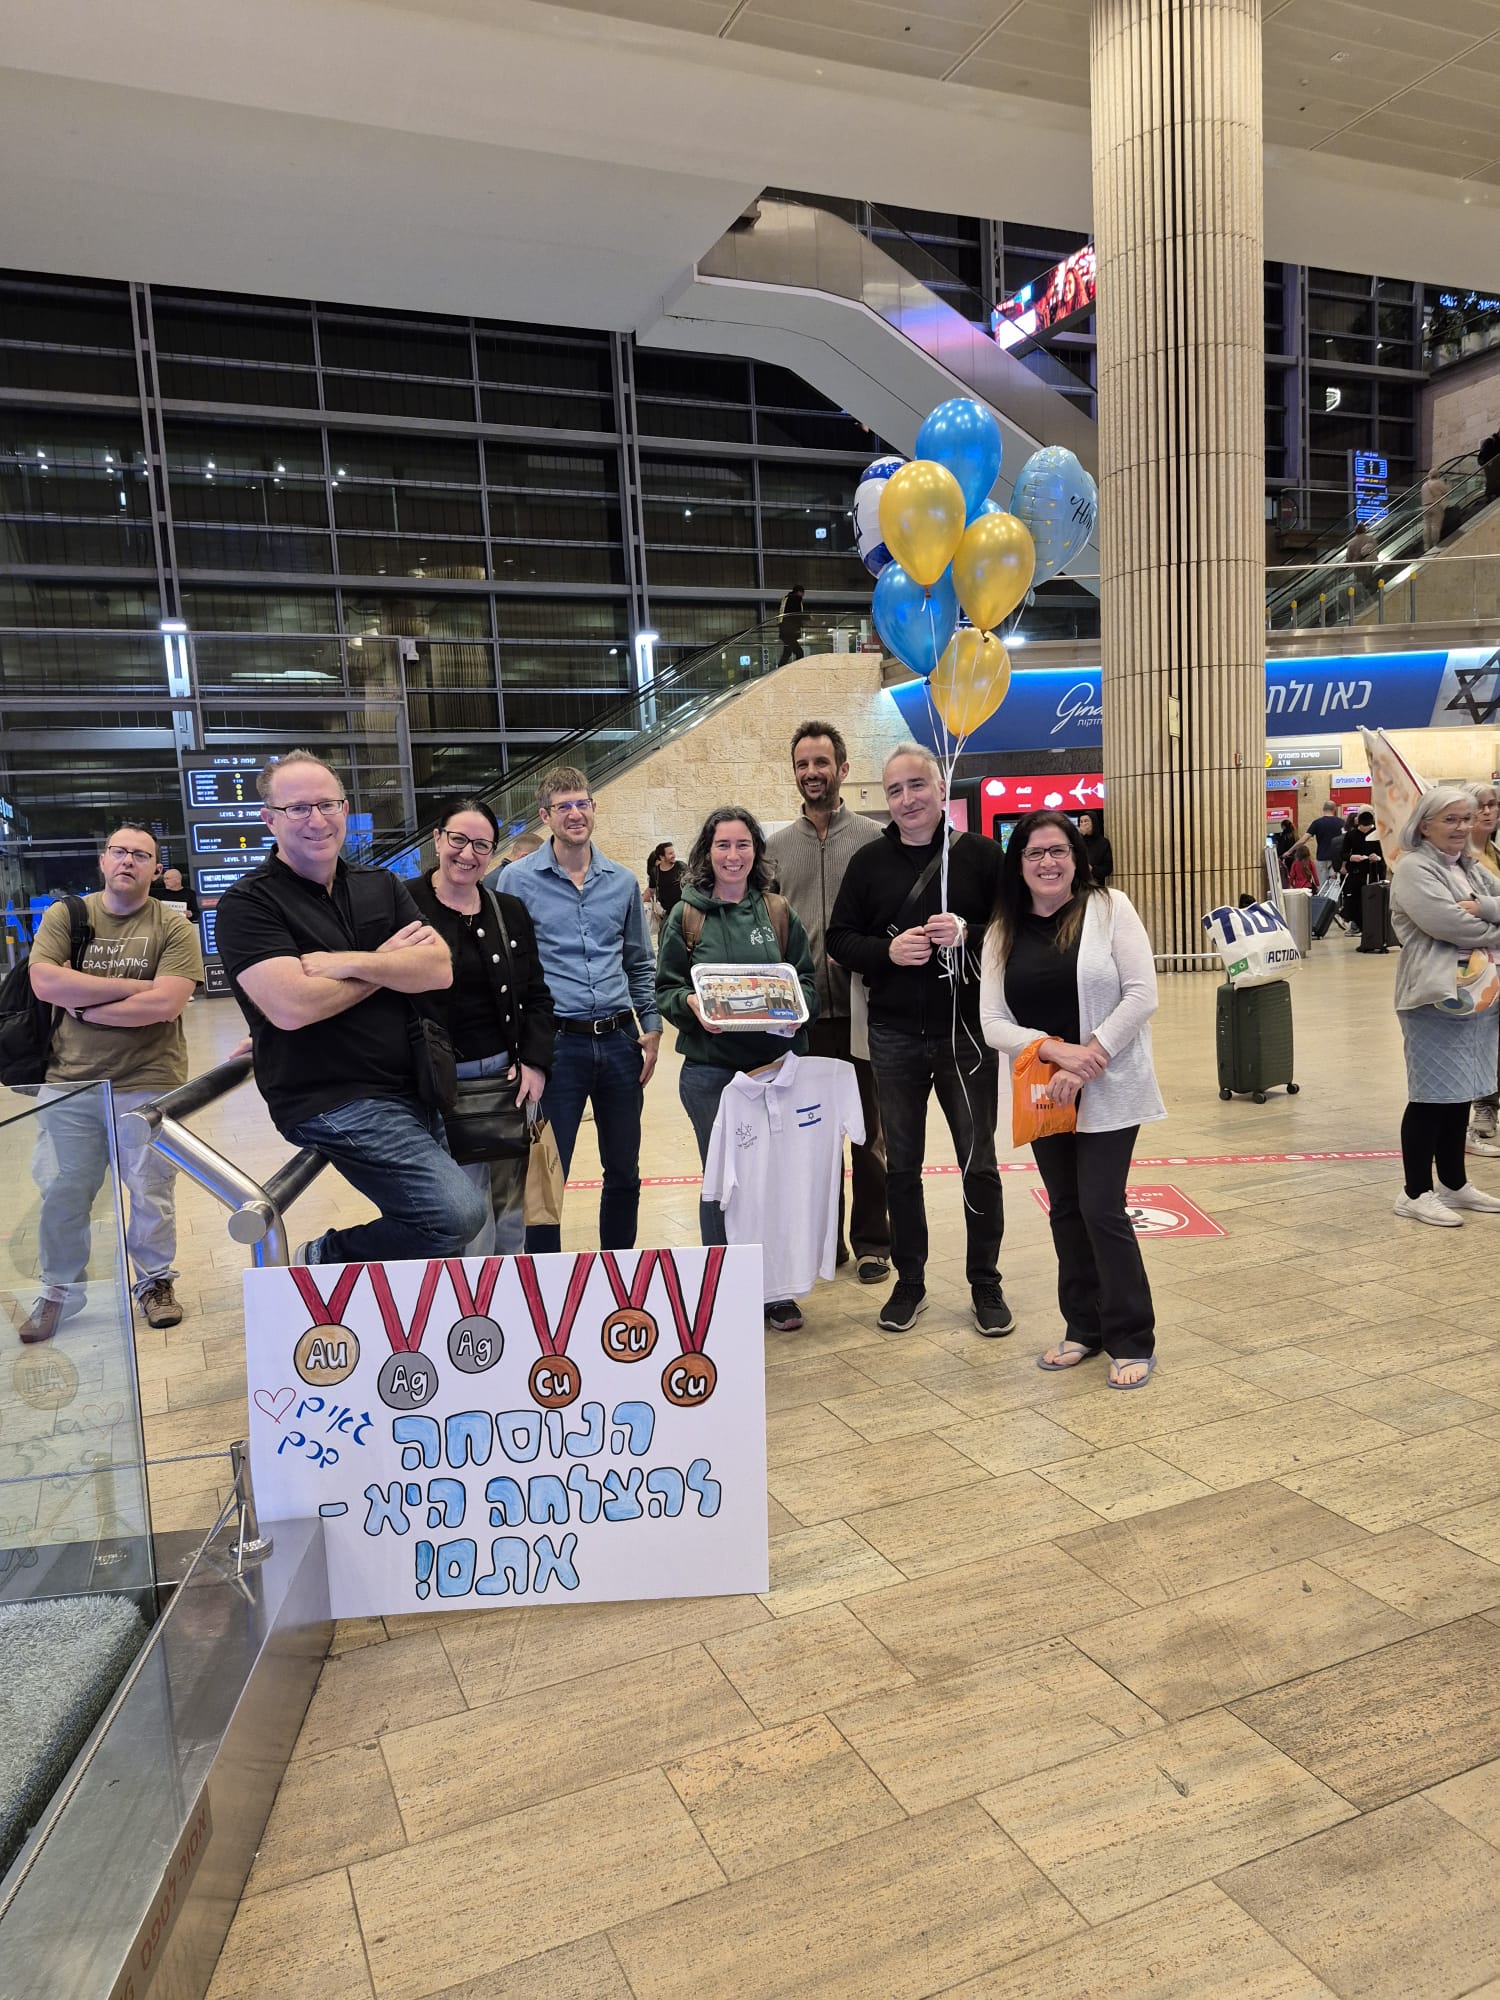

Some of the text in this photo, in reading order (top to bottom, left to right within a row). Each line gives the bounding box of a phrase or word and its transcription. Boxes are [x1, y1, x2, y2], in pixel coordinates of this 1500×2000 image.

[1266, 679, 1373, 717] כאן ולת
[232, 757, 238, 765] 3
[1278, 759, 1291, 767] ATM
[238, 810, 243, 818] 2
[82, 957, 149, 970] CRASTINATING
[89, 944, 125, 954] I'M NOT
[1267, 948, 1300, 964] ACTION
[456, 1330, 493, 1366] Ag
[608, 1321, 648, 1351] Cu
[305, 1338, 348, 1370] Au
[390, 1365, 429, 1402] Ag
[534, 1367, 571, 1398] Cu
[669, 1367, 708, 1398] Cu
[392, 1401, 656, 1471] הנוסחה
[363, 1477, 467, 1537] היא
[485, 1458, 722, 1528] להצלחה
